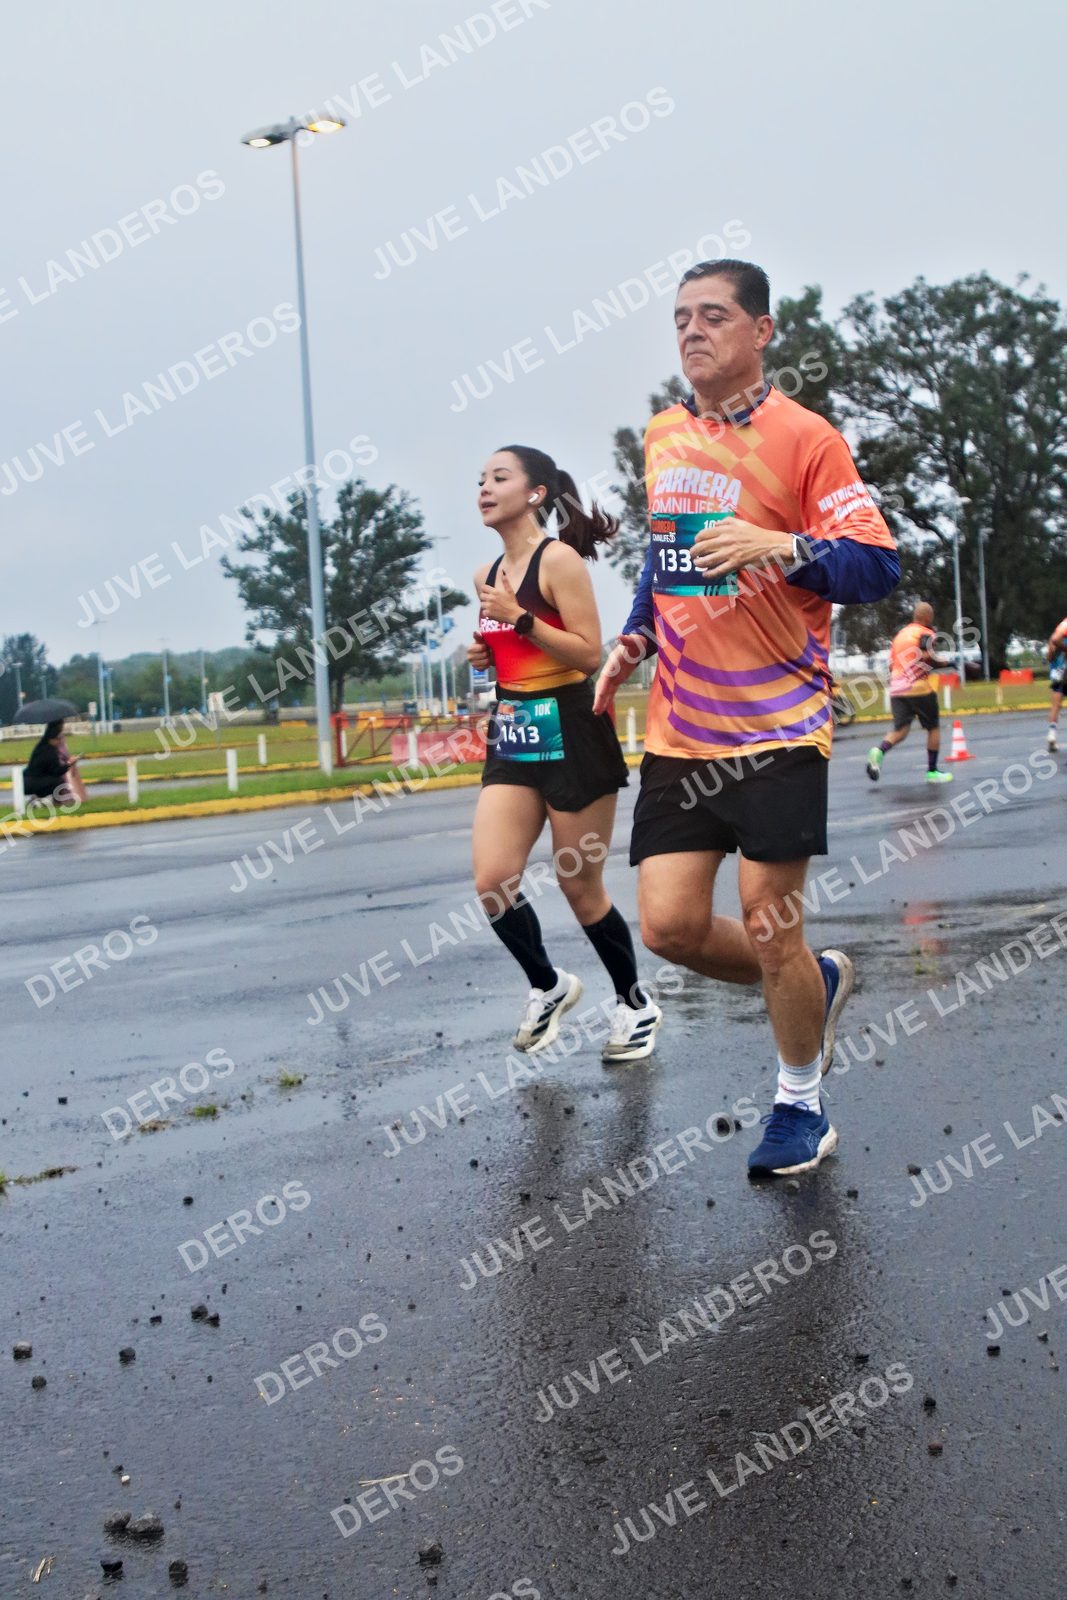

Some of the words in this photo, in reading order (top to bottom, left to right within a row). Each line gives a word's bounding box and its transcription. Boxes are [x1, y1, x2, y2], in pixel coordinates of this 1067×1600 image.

[654, 467, 742, 508] CARRERA
[703, 519, 721, 530] 10
[659, 548, 708, 572] 133
[534, 702, 551, 717] 10K
[501, 725, 540, 744] 1413
